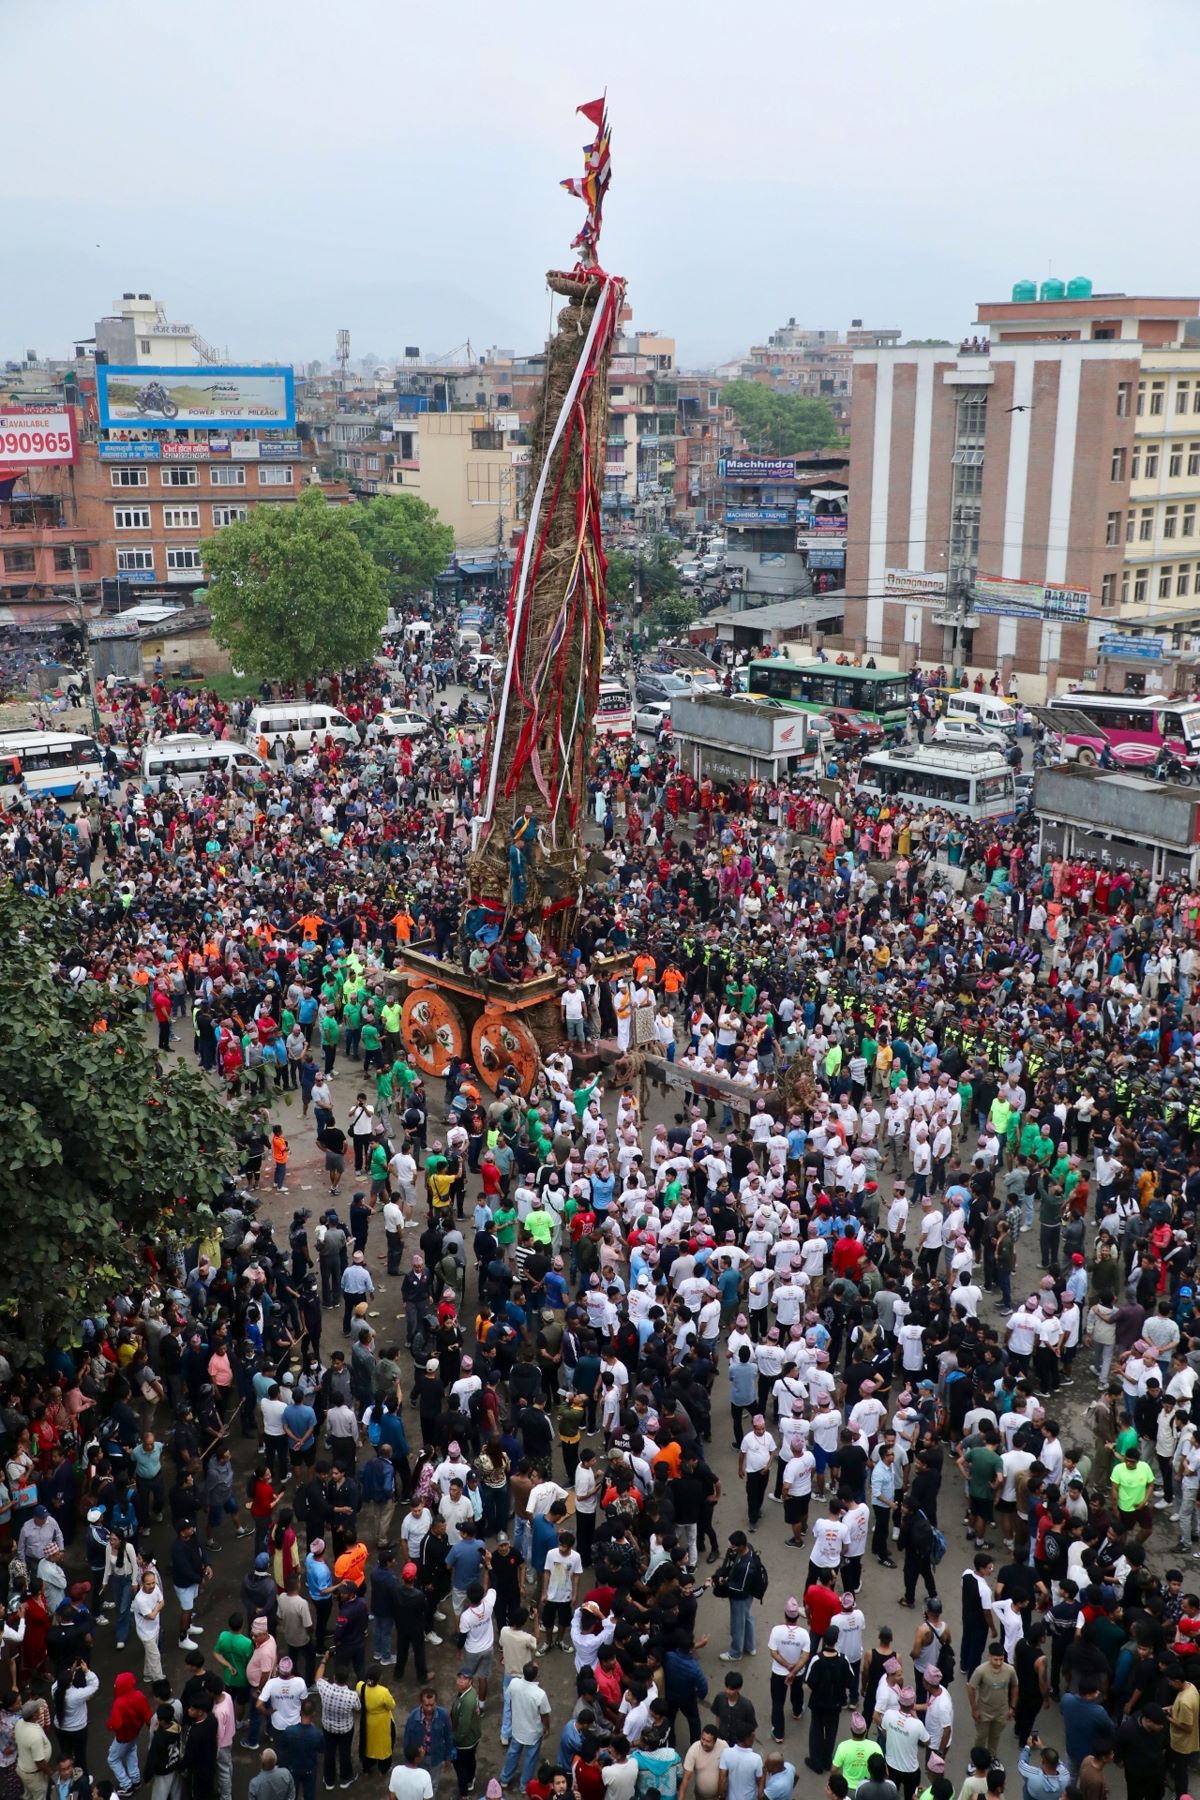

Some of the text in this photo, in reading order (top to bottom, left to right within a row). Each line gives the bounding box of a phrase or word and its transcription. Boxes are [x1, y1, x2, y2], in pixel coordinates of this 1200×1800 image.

[188, 408, 280, 416] POWER STYLE MILEAGE
[8, 419, 50, 428] AVAILABLE
[727, 460, 794, 469] Machhindra
